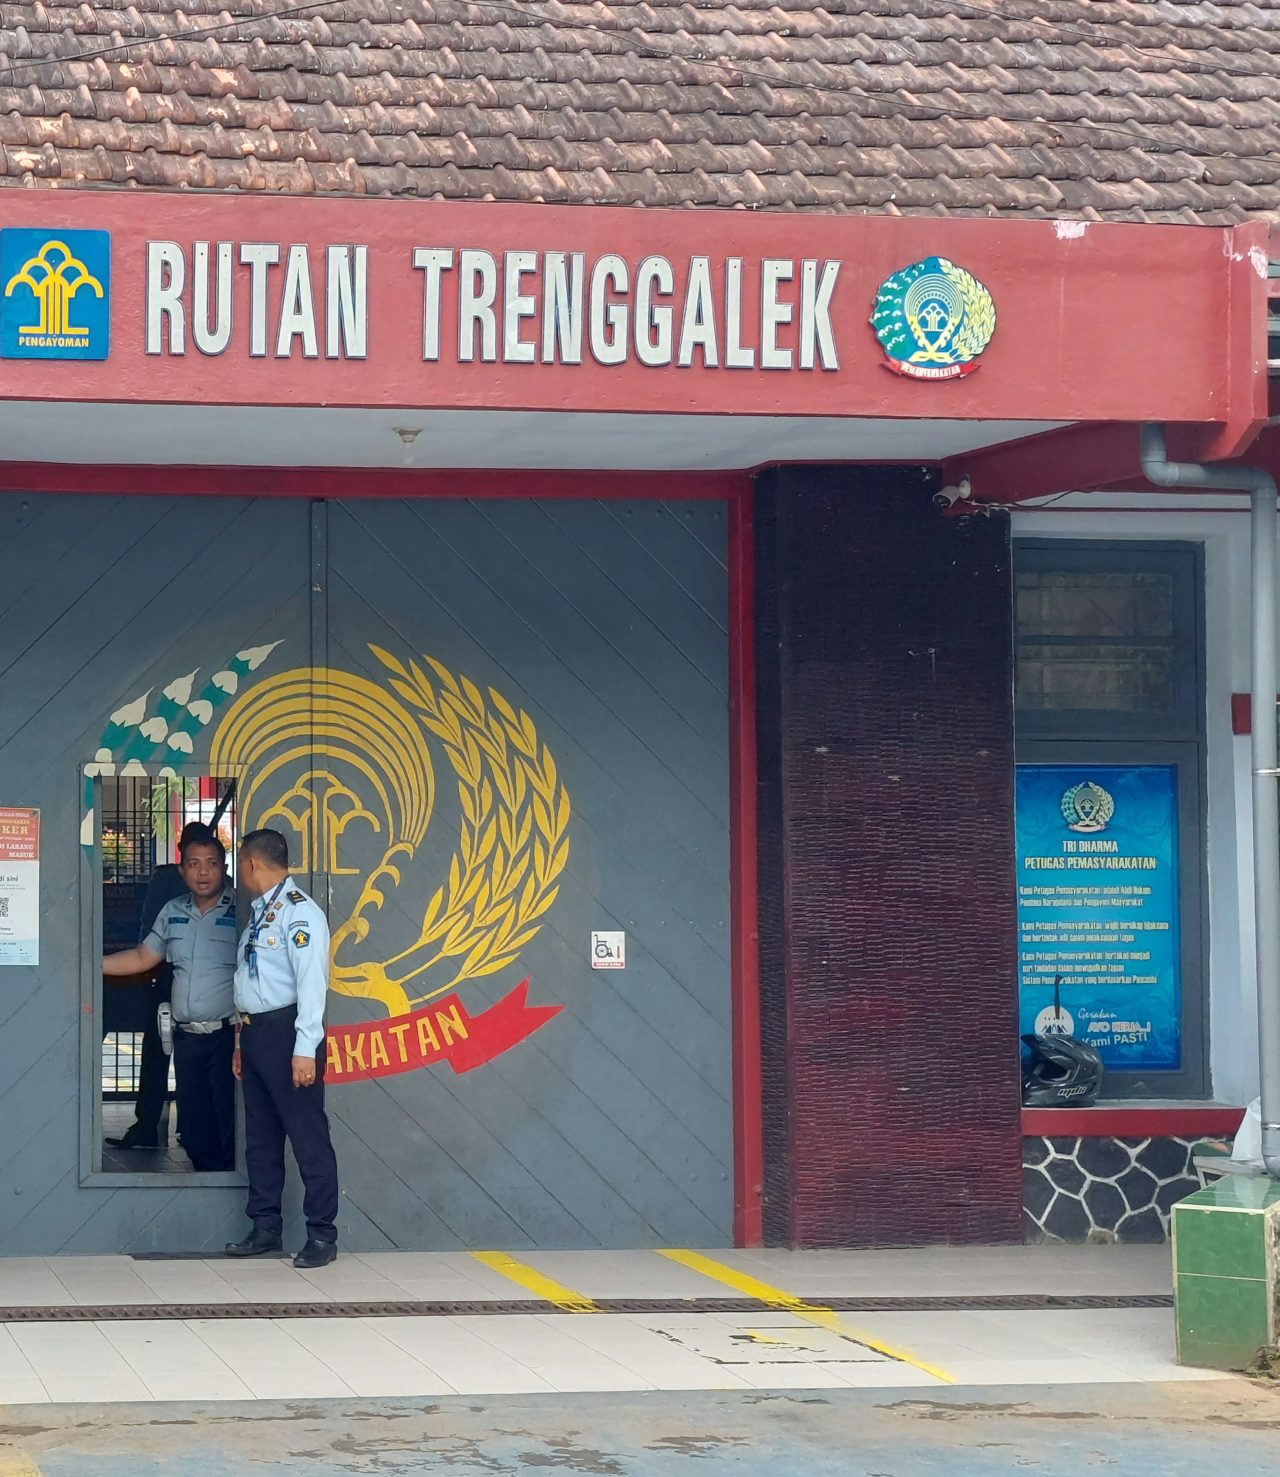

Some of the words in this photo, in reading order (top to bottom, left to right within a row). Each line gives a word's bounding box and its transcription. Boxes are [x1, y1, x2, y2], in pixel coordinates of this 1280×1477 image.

[145, 240, 368, 359] RUTAN
[412, 247, 843, 370] TRENGGALEK
[18, 336, 90, 347] PENGAYOMAN
[1063, 841, 1077, 853] TRI
[1079, 841, 1118, 853] DHARMA
[1025, 857, 1065, 869] PETUGAS
[1067, 857, 1157, 869] PEMASYARAKATAN
[1078, 1007, 1117, 1020] Gerakan
[1114, 1032, 1147, 1045] PASTI
